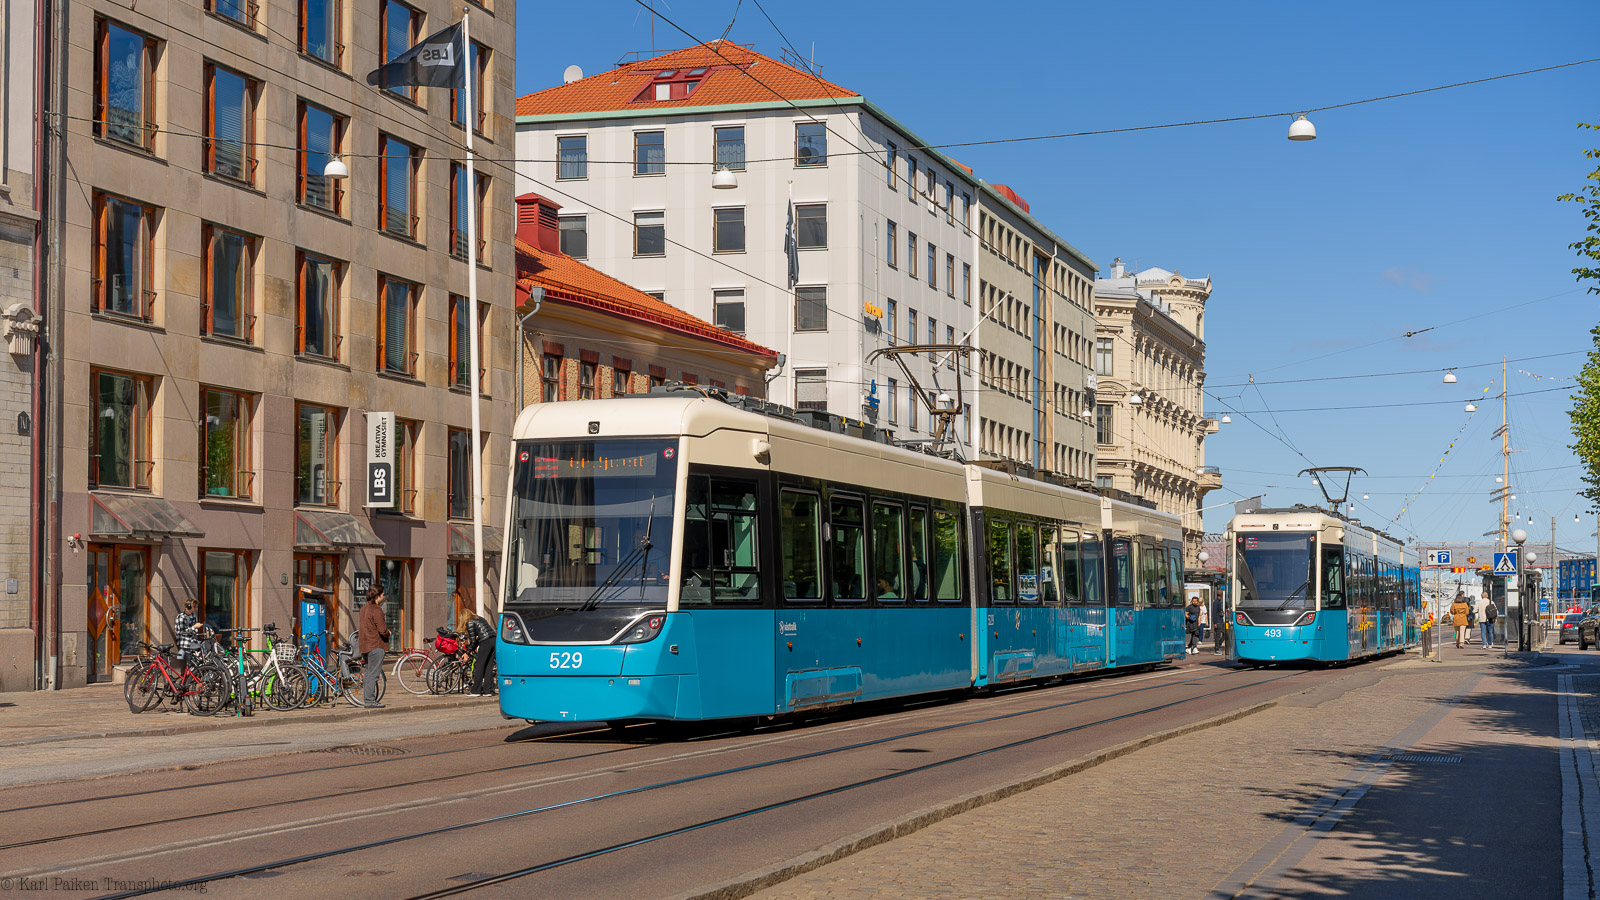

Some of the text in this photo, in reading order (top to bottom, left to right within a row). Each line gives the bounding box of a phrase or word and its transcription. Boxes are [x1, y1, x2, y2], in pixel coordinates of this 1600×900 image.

[373, 468, 386, 497] LBS
[1264, 629, 1282, 637] 493
[549, 651, 583, 669] 529
